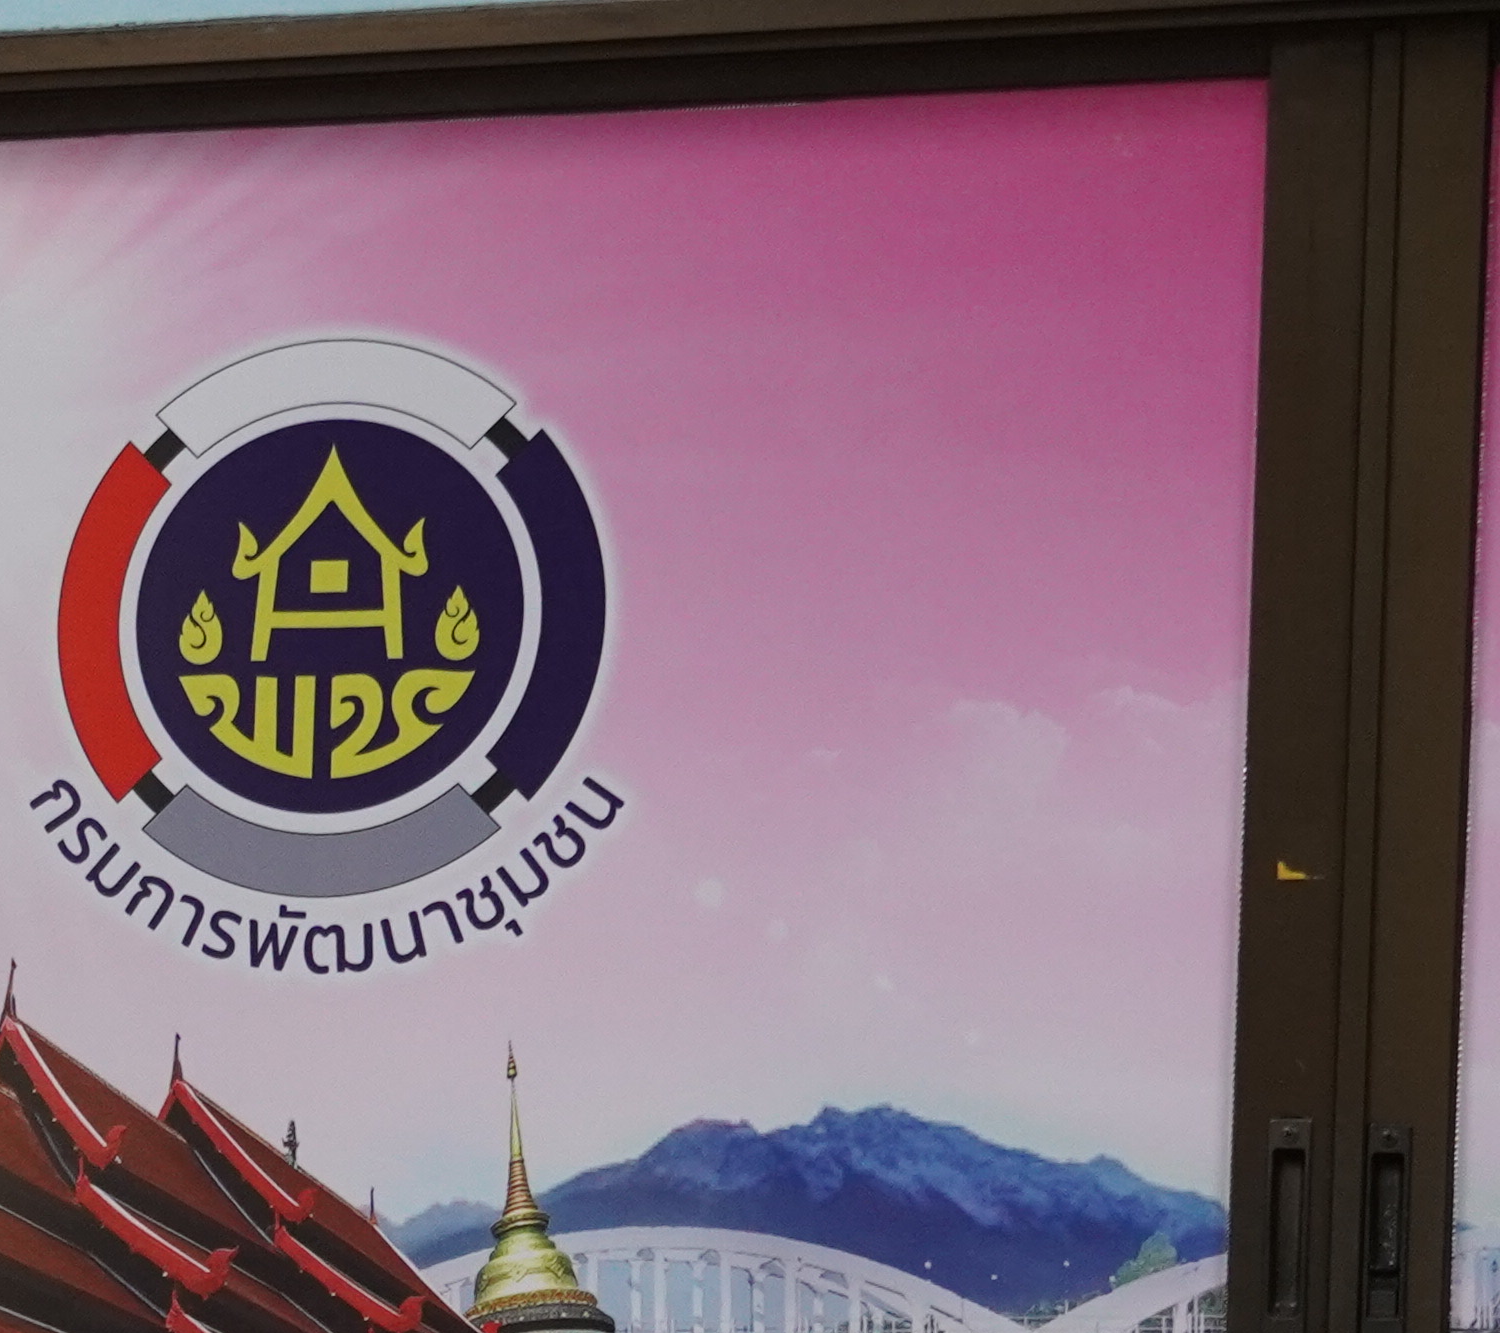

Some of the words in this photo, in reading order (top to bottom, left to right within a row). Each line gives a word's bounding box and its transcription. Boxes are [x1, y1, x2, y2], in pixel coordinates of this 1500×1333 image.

[30, 778, 625, 974] กรมการพัฒนาชุมชน
